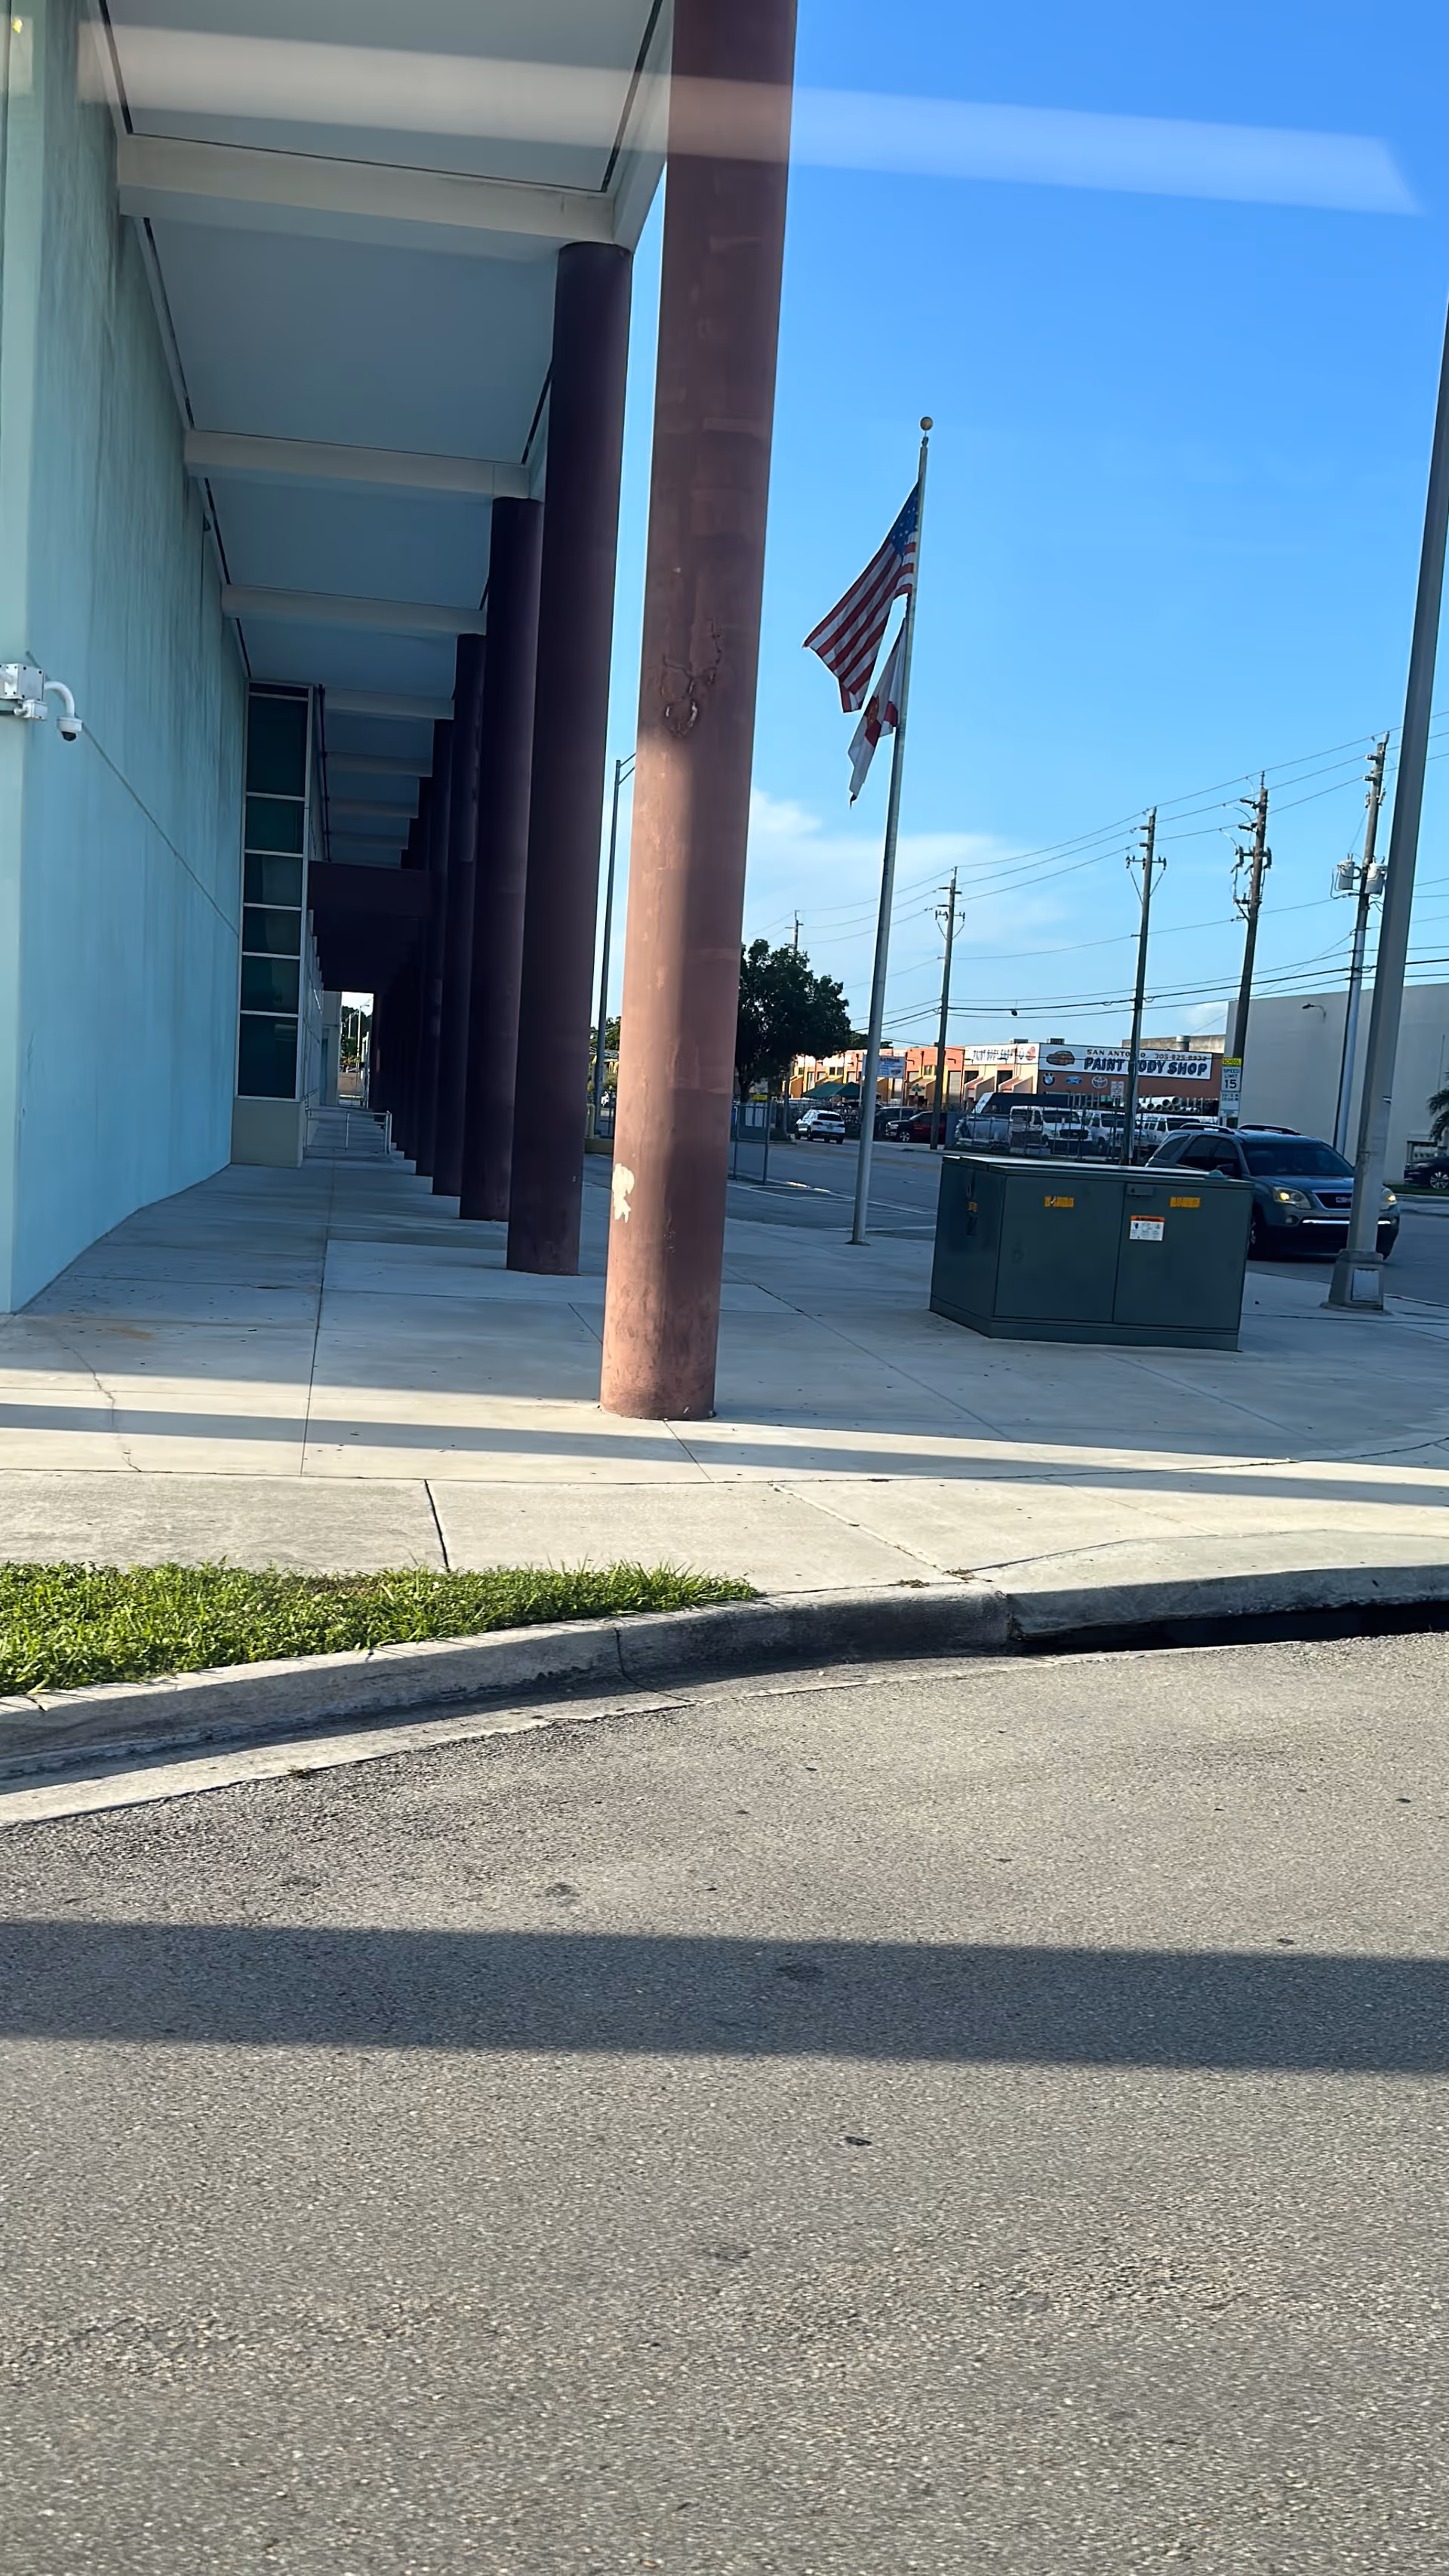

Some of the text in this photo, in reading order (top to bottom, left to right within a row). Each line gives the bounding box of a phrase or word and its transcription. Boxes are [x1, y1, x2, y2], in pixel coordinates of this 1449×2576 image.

[1084, 1057, 1208, 1076] PAINT ODY SHOP
[1225, 1079, 1237, 1088] 15
